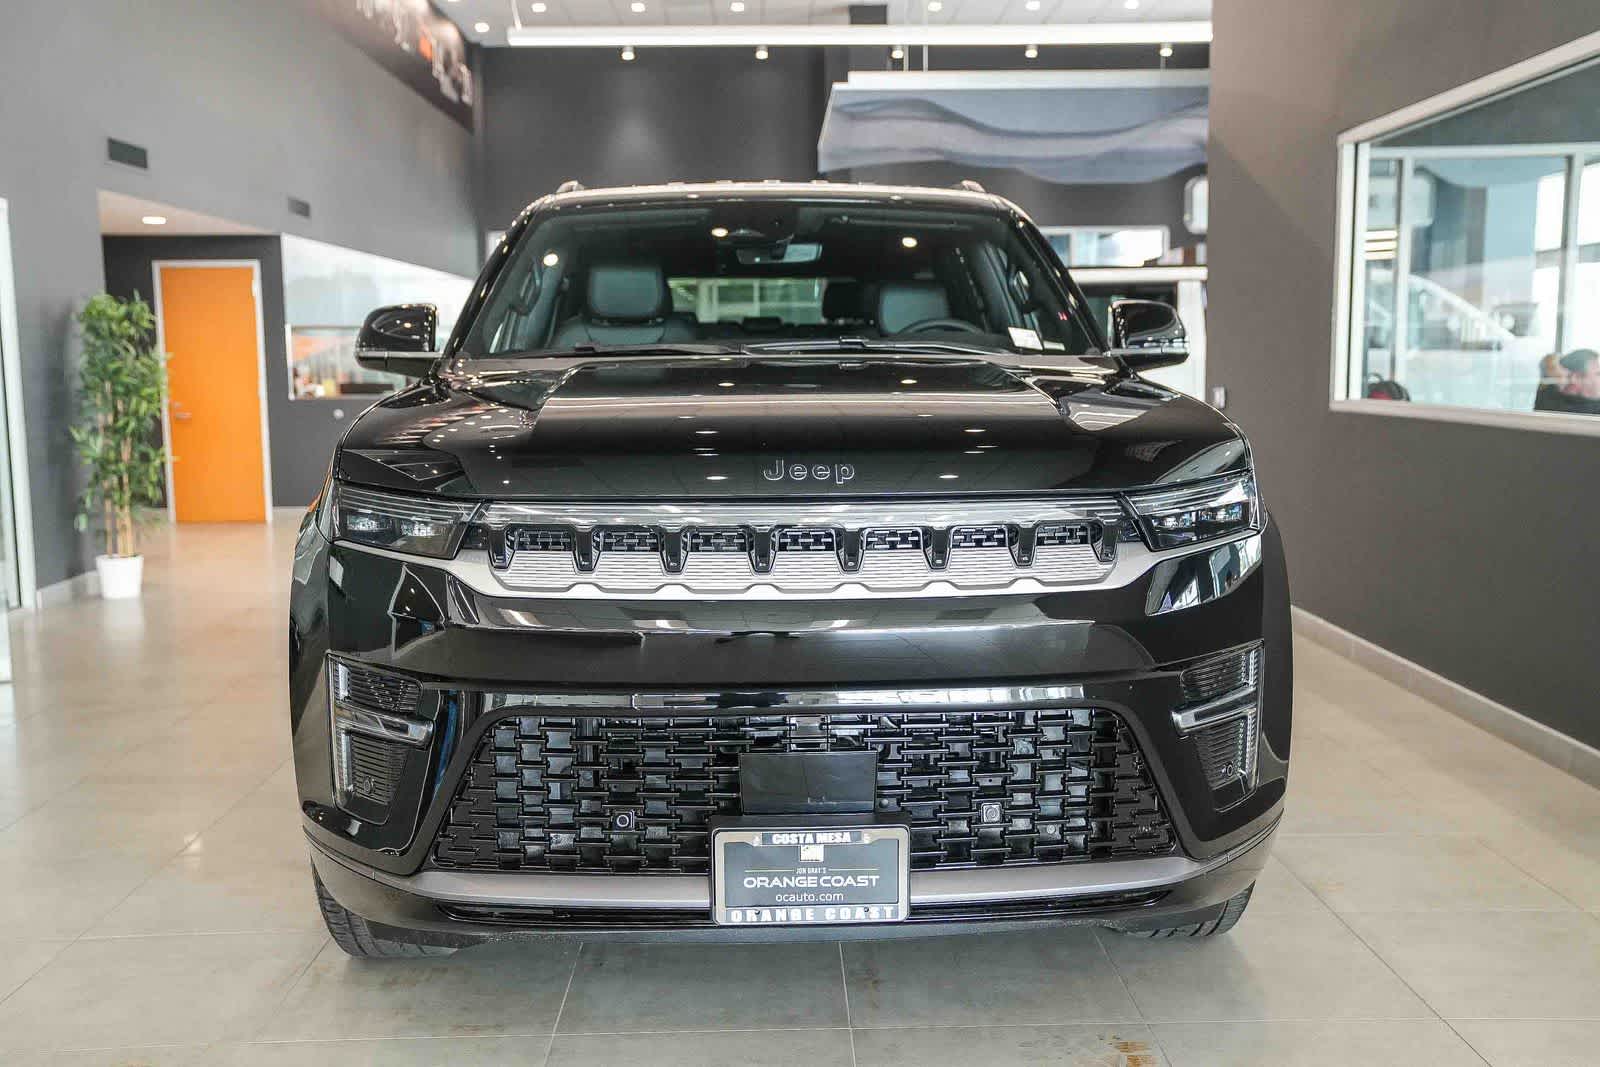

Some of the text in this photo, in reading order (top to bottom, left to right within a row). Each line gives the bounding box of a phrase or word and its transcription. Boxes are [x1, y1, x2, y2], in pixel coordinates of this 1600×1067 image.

[764, 459, 854, 484] Jeep
[772, 832, 852, 844] COSTA MESA
[743, 875, 880, 889] ORANGE COAST
[775, 892, 844, 902] ocauto.com
[731, 906, 894, 923] ORANGE COAST
